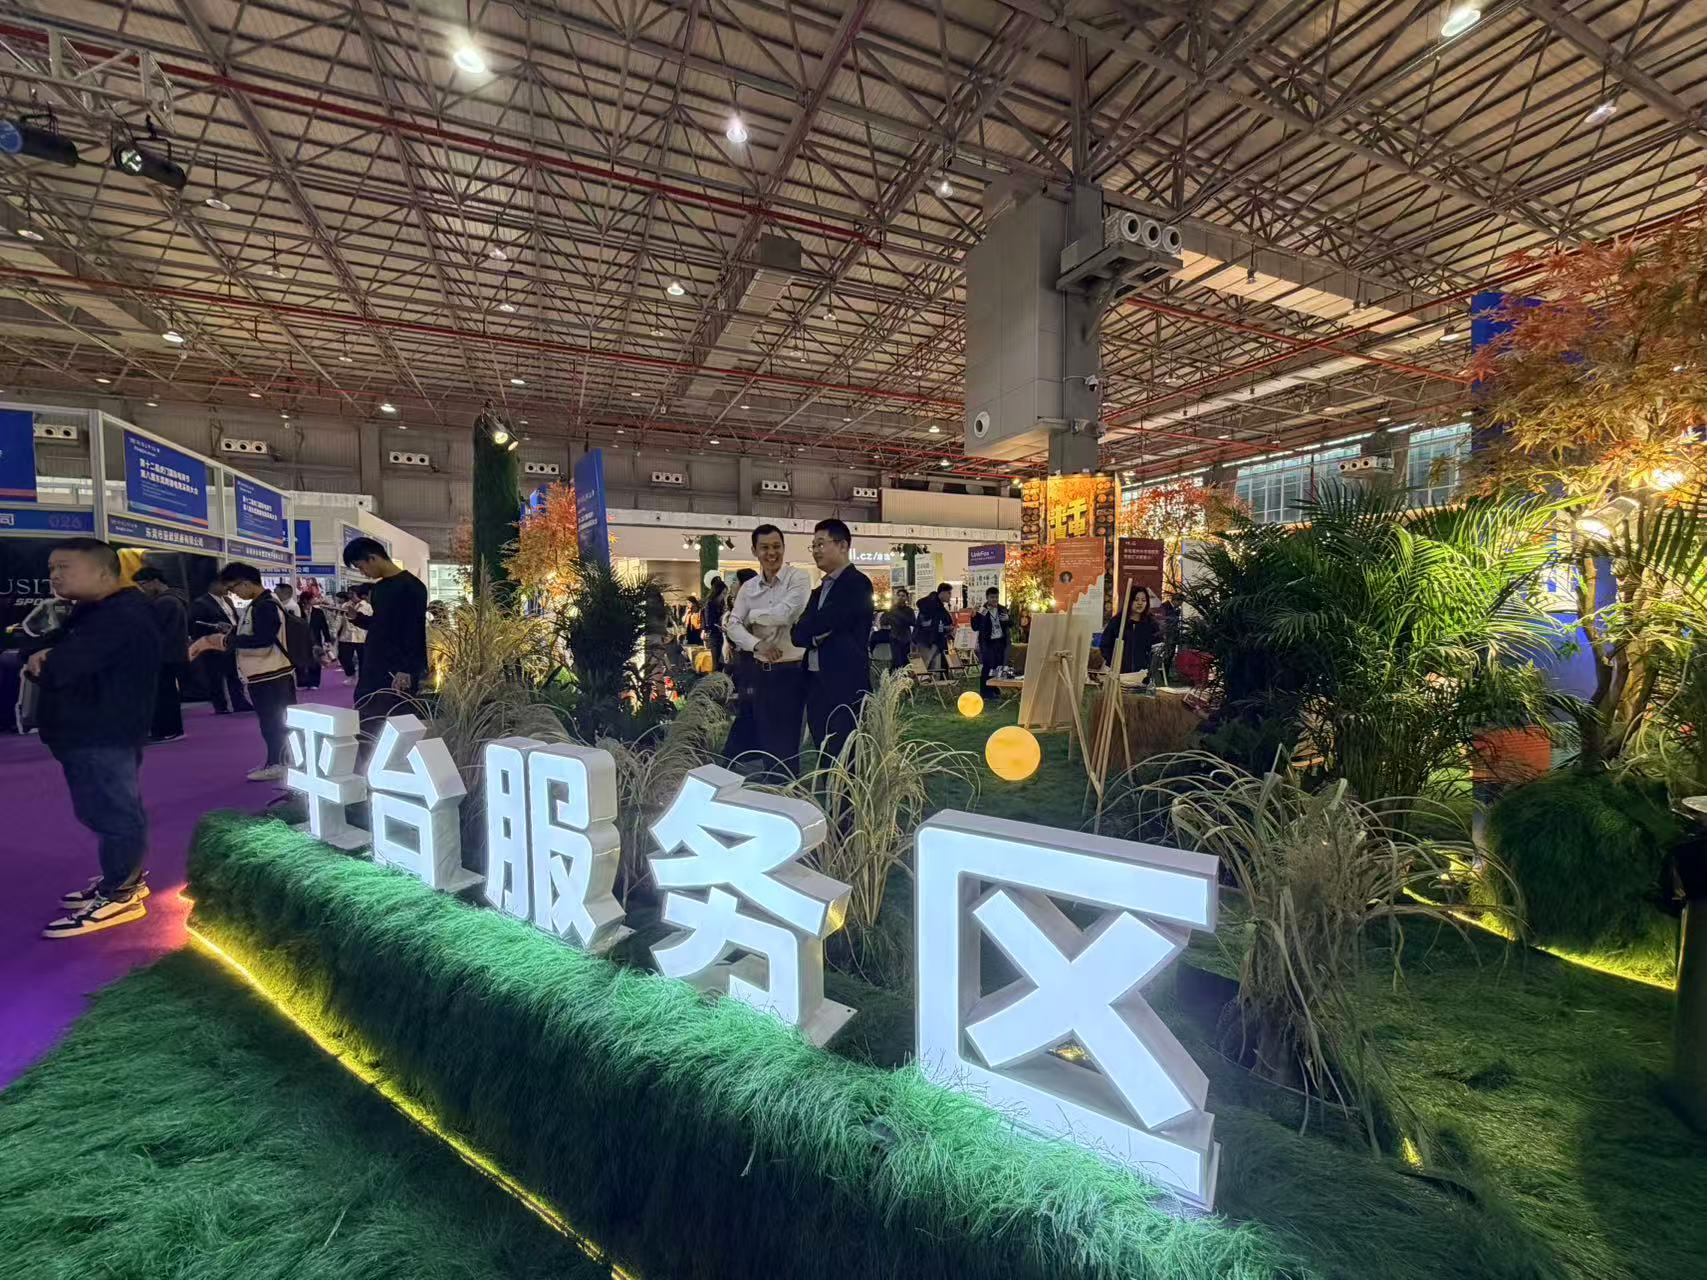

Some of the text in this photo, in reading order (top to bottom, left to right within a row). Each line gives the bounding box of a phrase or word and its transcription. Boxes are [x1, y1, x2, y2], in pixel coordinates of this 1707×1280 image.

[285, 703, 1218, 1208] 平台服务区
